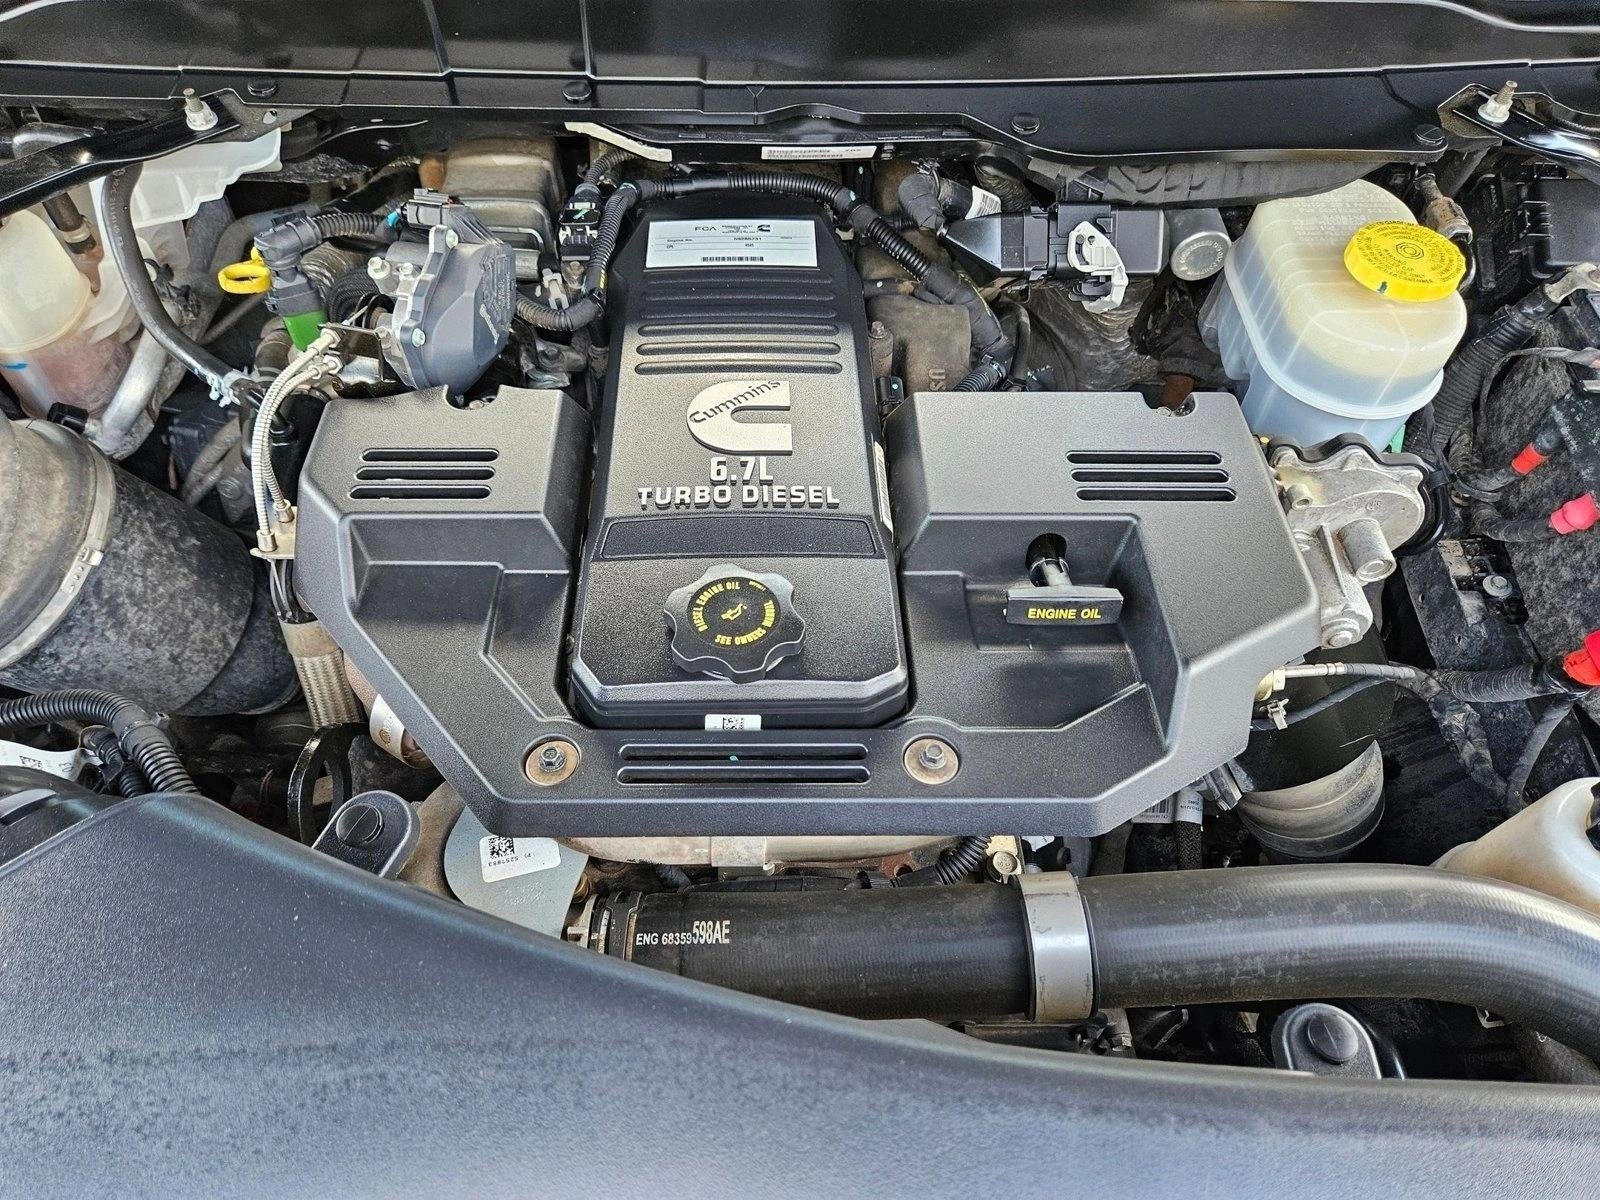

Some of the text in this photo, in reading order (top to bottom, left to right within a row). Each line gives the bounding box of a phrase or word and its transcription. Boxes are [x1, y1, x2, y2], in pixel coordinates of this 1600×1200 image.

[689, 380, 781, 423] Cummins
[710, 456, 774, 484] 6.7L
[638, 485, 840, 509] TURBO DIESEL
[696, 583, 725, 606] ENGINE
[726, 581, 741, 590] OIL
[1027, 608, 1101, 619] ENGINE OIL
[714, 634, 732, 645] SEE
[734, 627, 767, 645] OWNERS
[635, 932, 659, 945] ENG
